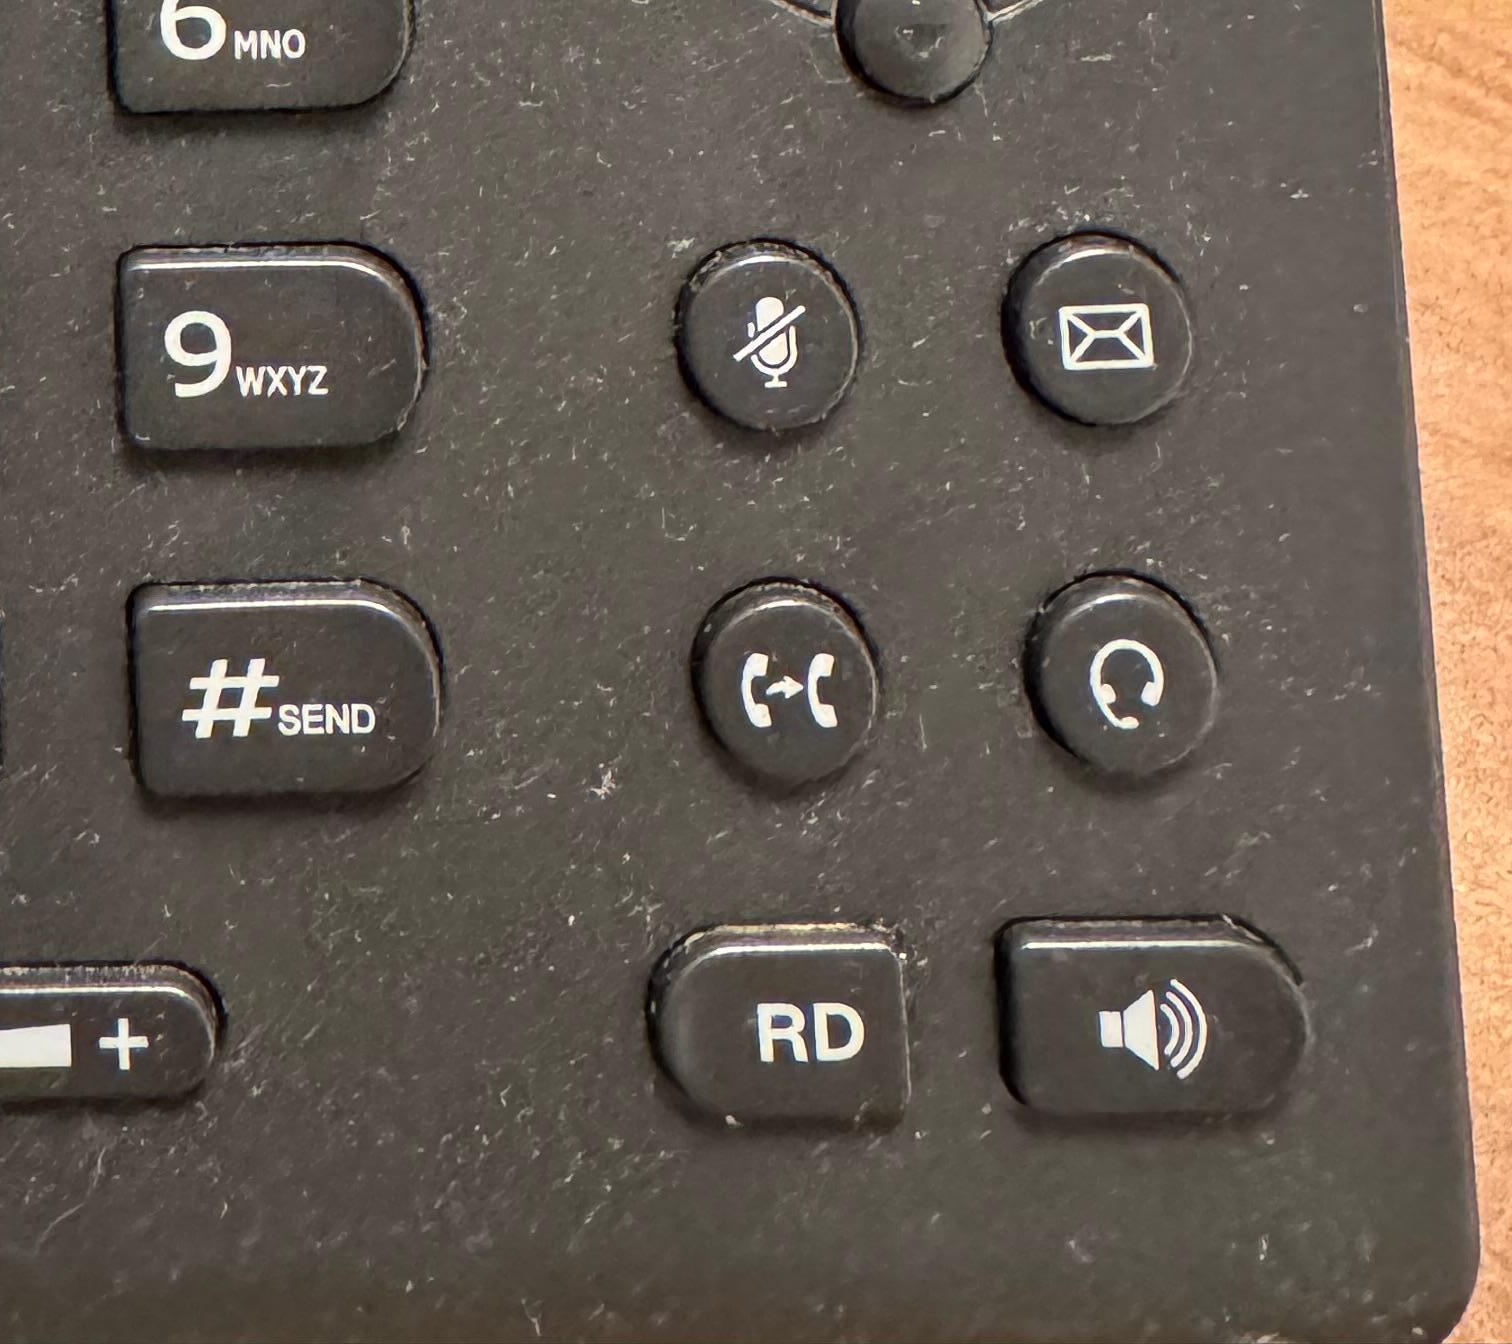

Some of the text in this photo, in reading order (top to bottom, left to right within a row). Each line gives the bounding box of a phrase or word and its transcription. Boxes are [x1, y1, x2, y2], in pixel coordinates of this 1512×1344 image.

[234, 28, 306, 60] MNO
[164, 311, 329, 398] 9 WXYZ
[278, 703, 376, 736] SEND
[756, 1002, 865, 1063] RD
